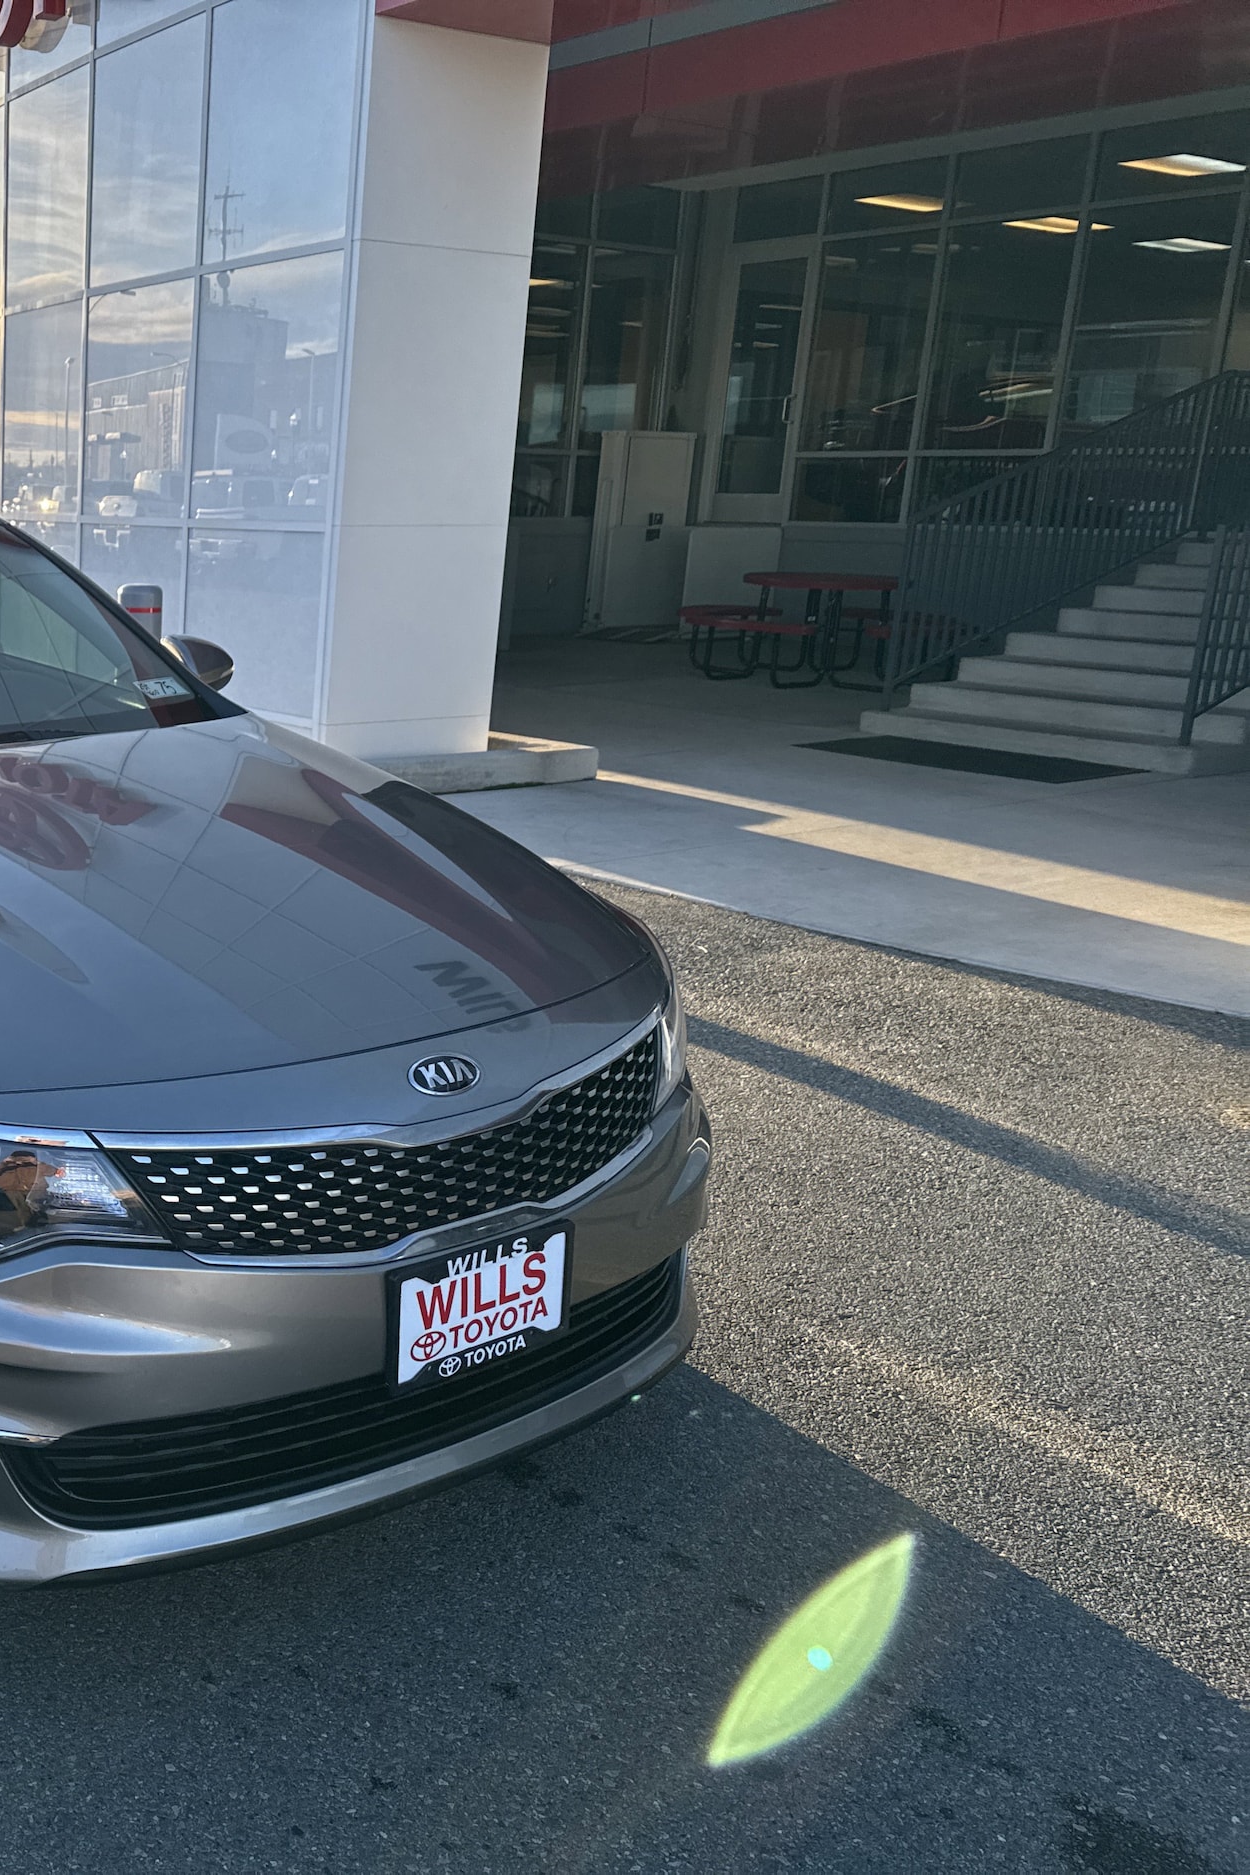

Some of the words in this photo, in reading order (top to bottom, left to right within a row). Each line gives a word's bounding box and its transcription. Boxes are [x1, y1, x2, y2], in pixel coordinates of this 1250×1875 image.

[417, 1058, 475, 1089] KIA
[447, 1237, 528, 1277] WILLS
[416, 1252, 546, 1330] WILLS
[449, 1296, 548, 1348] TOYOTA
[464, 1334, 526, 1367] TOYOTA
